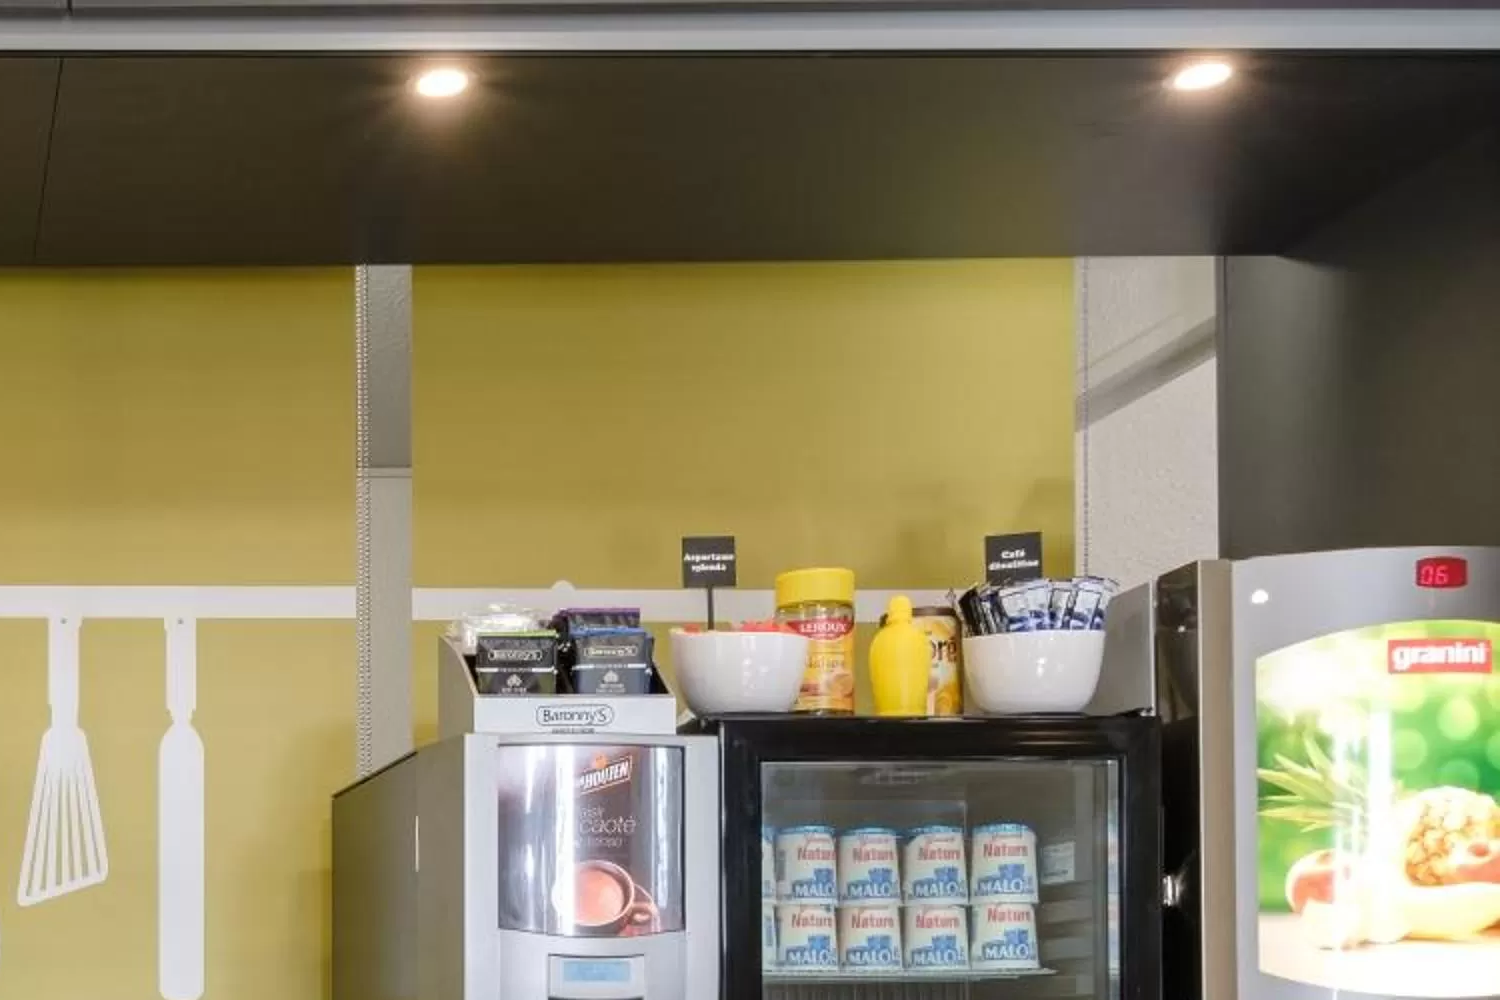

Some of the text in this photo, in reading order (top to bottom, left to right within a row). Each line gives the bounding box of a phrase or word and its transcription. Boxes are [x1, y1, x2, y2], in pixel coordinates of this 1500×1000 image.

[1001, 549, 1026, 559] Café
[1420, 565, 1449, 585] 06
[800, 622, 848, 633] LEROUX
[1393, 641, 1486, 671] granini
[798, 848, 836, 861] Natur
[985, 943, 1029, 959] MALO
